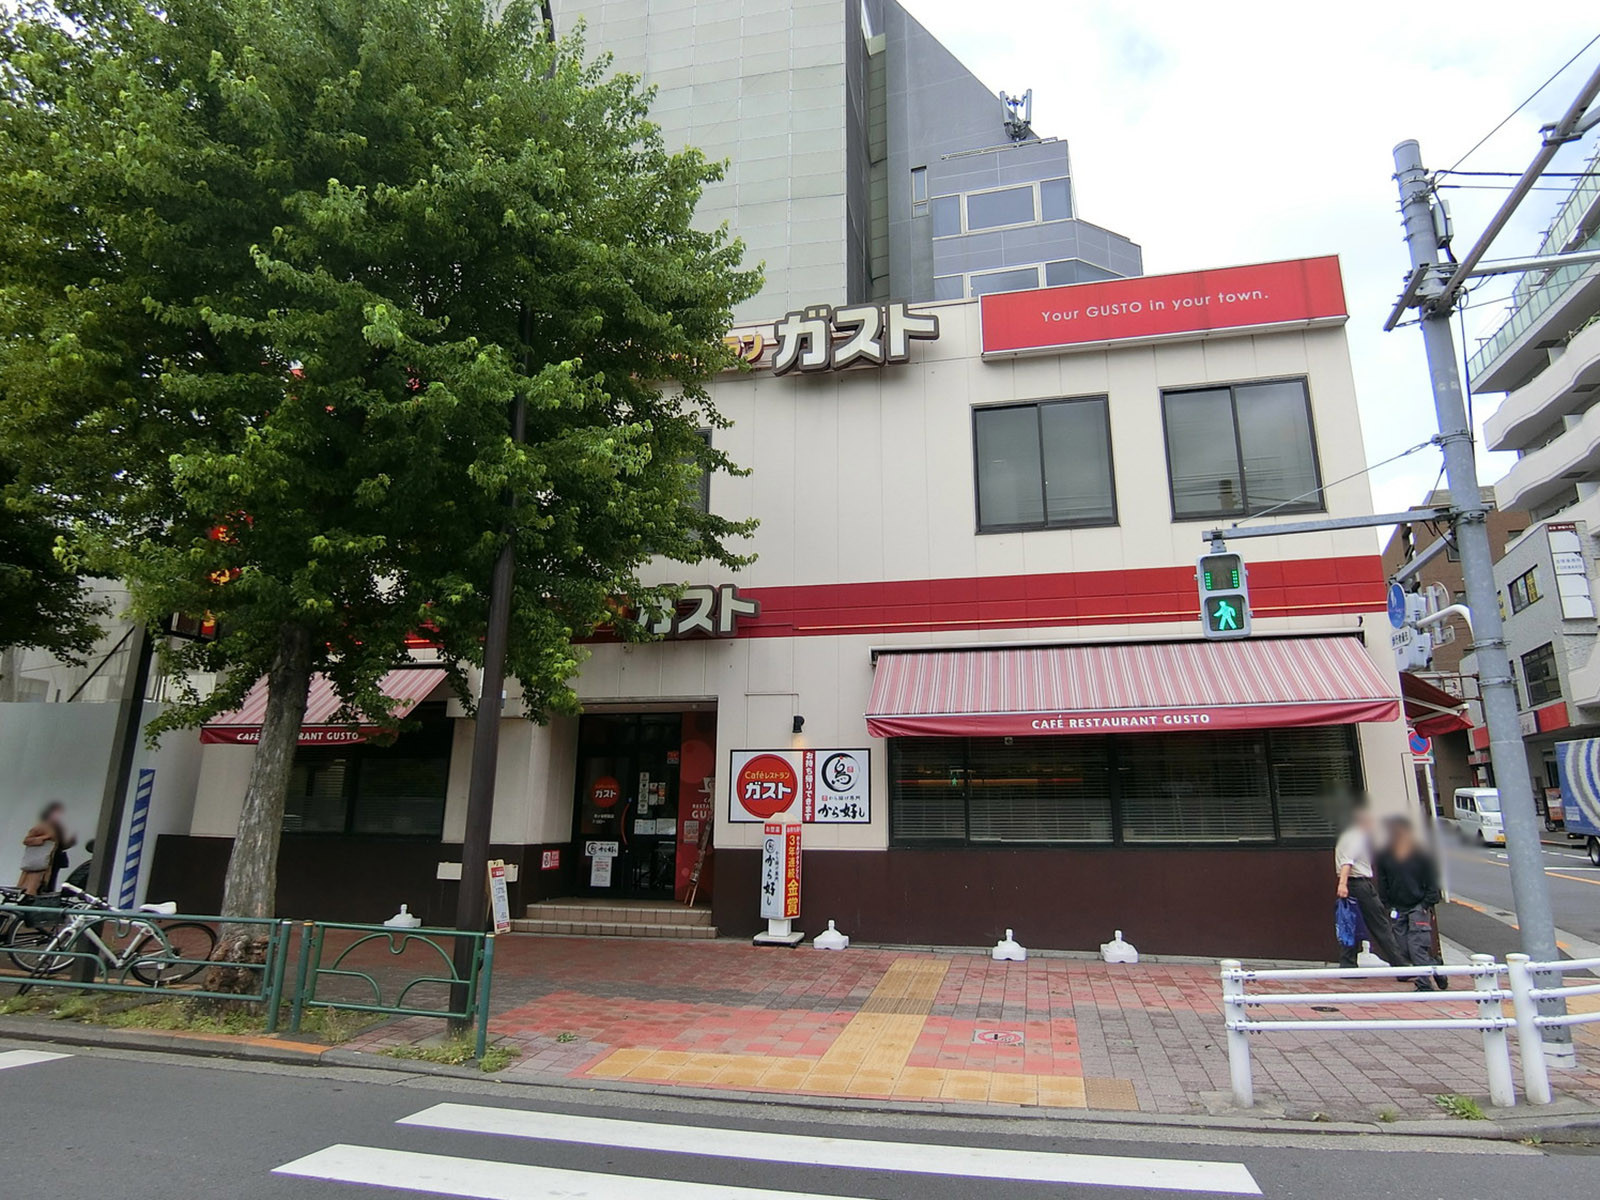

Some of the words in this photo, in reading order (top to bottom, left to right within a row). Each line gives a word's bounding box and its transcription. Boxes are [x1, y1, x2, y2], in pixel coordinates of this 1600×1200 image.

[1041, 309, 1079, 322] Your
[1086, 301, 1142, 318] GUSTO
[1149, 299, 1165, 311] in
[1172, 296, 1211, 311] your
[1218, 289, 1269, 304] town.
[722, 334, 764, 363] ラン
[772, 303, 940, 376] ガスト
[1031, 714, 1064, 729] CAFÉ
[1069, 715, 1157, 728] RESTAURANT
[1163, 713, 1210, 725] GUSTO
[298, 732, 324, 740] RANT
[326, 731, 359, 740] GUSTO
[595, 789, 617, 798] ガスト
[744, 782, 792, 800] ガスト
[805, 751, 815, 821] お持ち帰りできます
[817, 802, 866, 820] から好し
[763, 854, 775, 906] から好し
